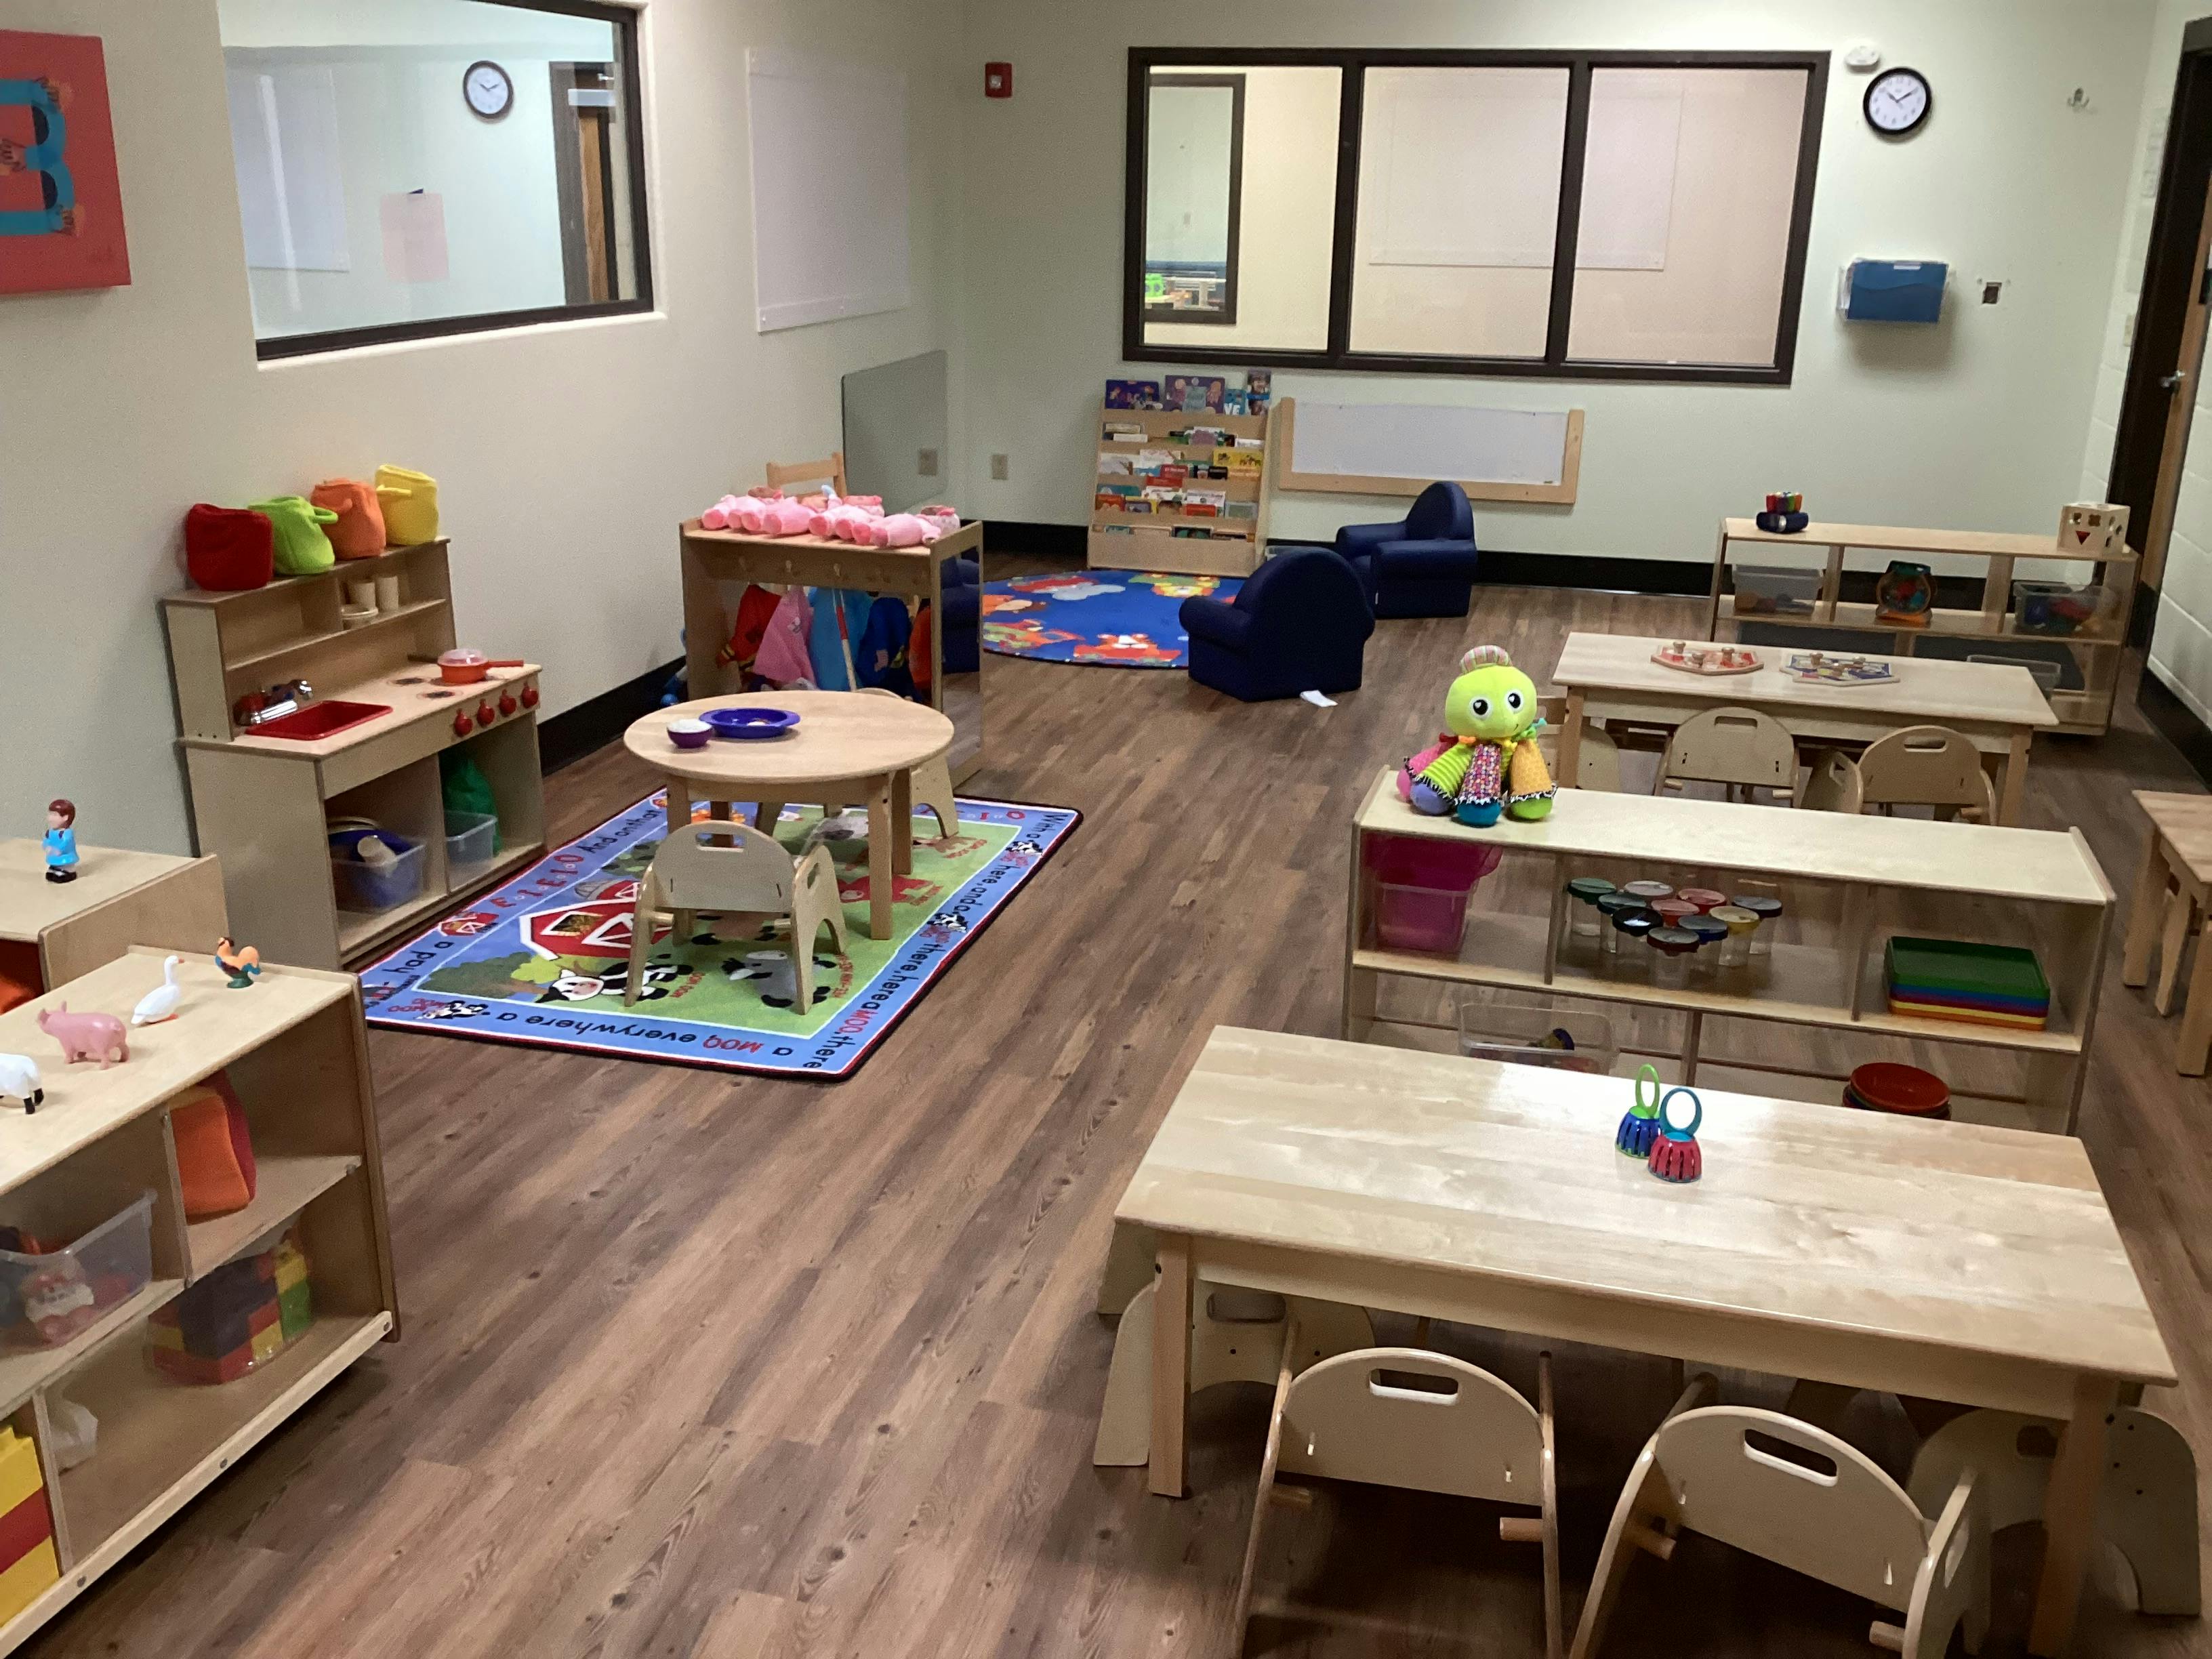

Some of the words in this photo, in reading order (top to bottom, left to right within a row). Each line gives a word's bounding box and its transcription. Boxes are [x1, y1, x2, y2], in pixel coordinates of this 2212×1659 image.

[575, 836, 618, 854] And
[960, 886, 987, 906] and
[382, 950, 436, 974] had
[434, 941, 455, 949] a
[871, 974, 919, 1001] here
[861, 1002, 881, 1010] a
[495, 1012, 518, 1021] a
[525, 1015, 697, 1043] everywhere
[771, 1046, 794, 1056] a
[803, 1035, 856, 1069] there
